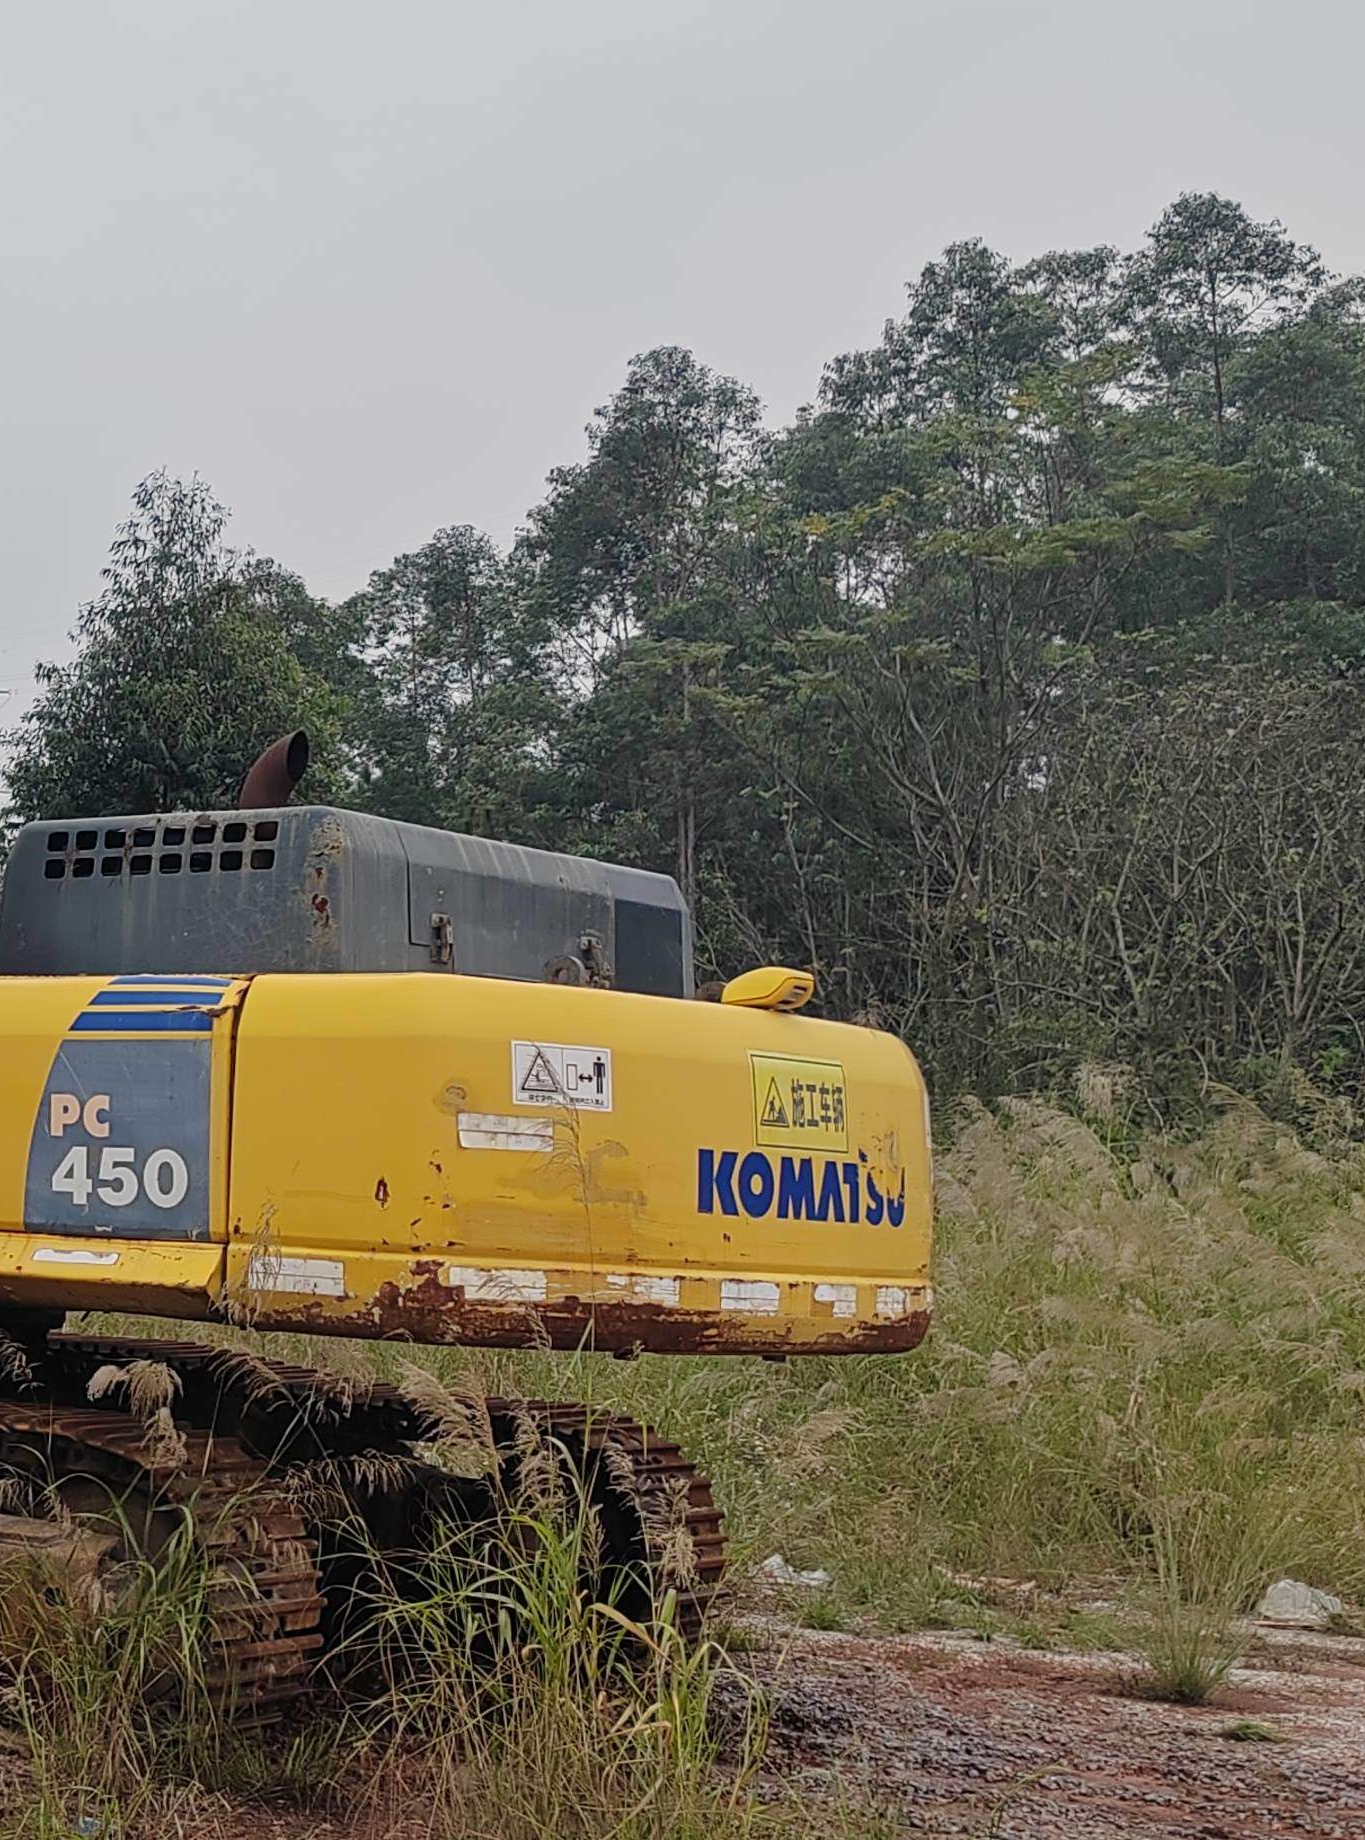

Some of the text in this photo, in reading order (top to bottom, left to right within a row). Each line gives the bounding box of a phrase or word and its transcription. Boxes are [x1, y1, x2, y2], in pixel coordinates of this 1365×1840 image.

[51, 1093, 110, 1138] PC
[790, 1077, 845, 1133] 施工车辆
[52, 1146, 188, 1208] 450
[697, 1148, 905, 1228] KOMATSU
